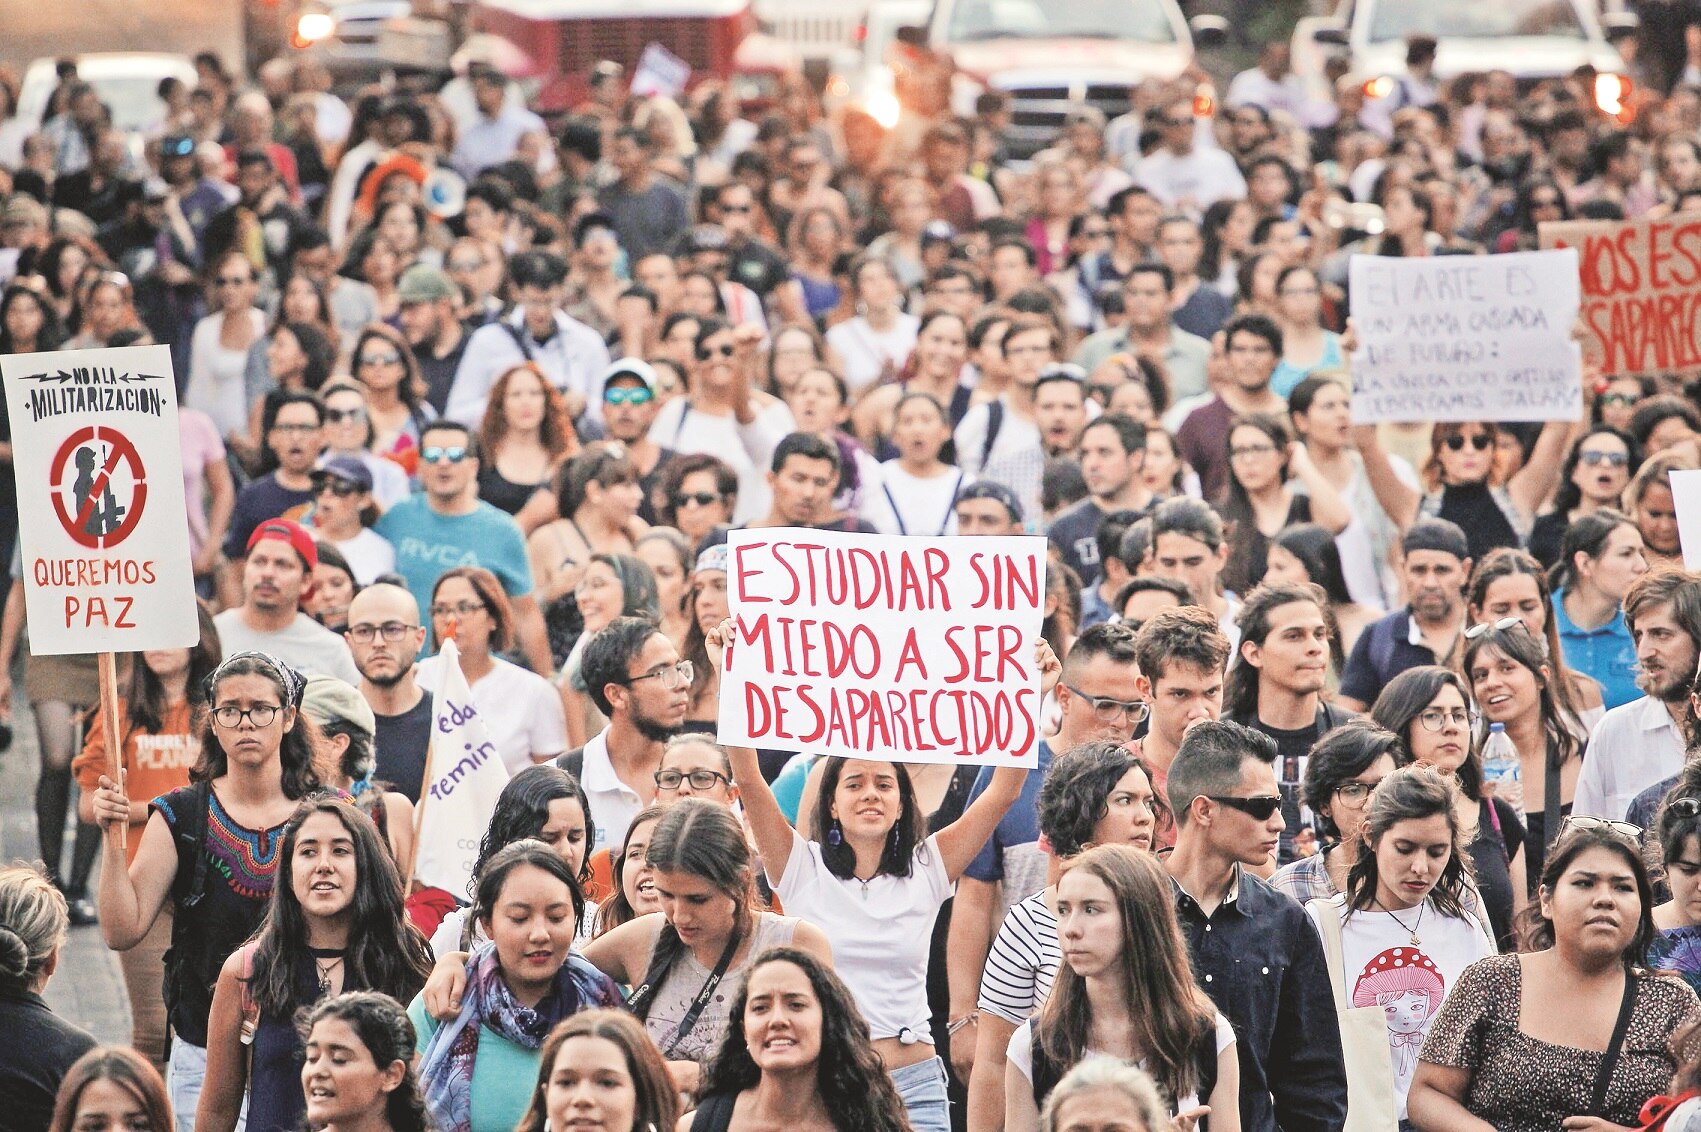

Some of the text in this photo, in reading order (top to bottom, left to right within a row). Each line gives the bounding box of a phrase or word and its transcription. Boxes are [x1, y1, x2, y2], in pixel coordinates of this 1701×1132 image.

[1412, 266, 1484, 302] ARTE
[1505, 263, 1537, 297] ES
[72, 366, 117, 385] NO A LA
[34, 557, 157, 588] QUEREMOS
[735, 542, 1039, 612] ESTUDIAR SIN
[65, 595, 137, 629] PAZ
[725, 613, 1029, 684] MIEDO A SER
[744, 681, 1036, 757] DESAPARECIDOS
[627, 983, 650, 1006] Canon
